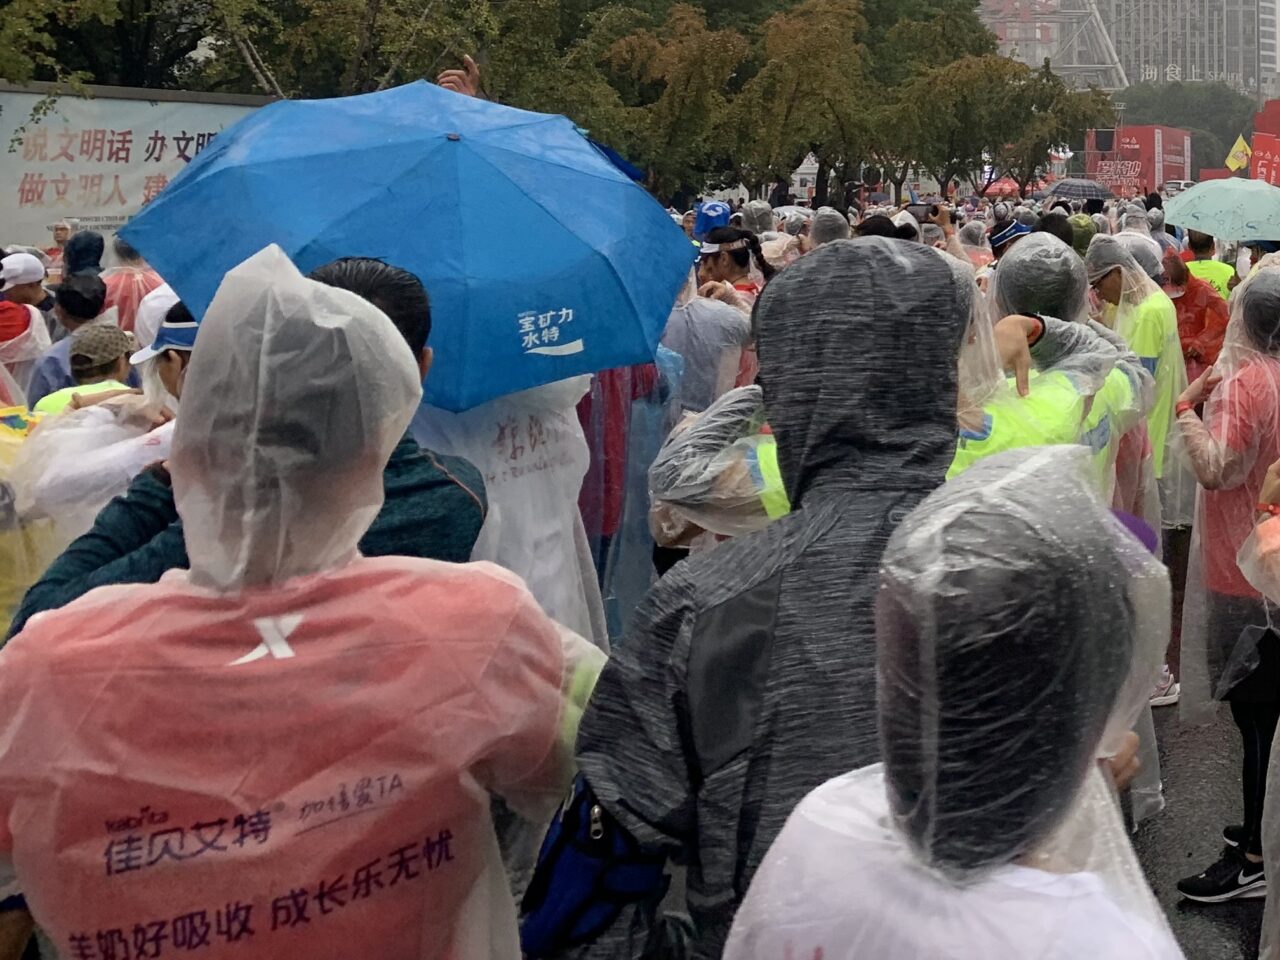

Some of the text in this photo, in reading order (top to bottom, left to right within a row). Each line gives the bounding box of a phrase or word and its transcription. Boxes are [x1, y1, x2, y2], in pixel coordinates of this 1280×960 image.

[18, 172, 128, 208] 做文明人
[518, 307, 574, 333] 宝矿力
[521, 326, 560, 348] 水特
[103, 809, 272, 876] 佳贝艾特
[67, 828, 456, 960] 羊奶好吸收 成长乐无忧
